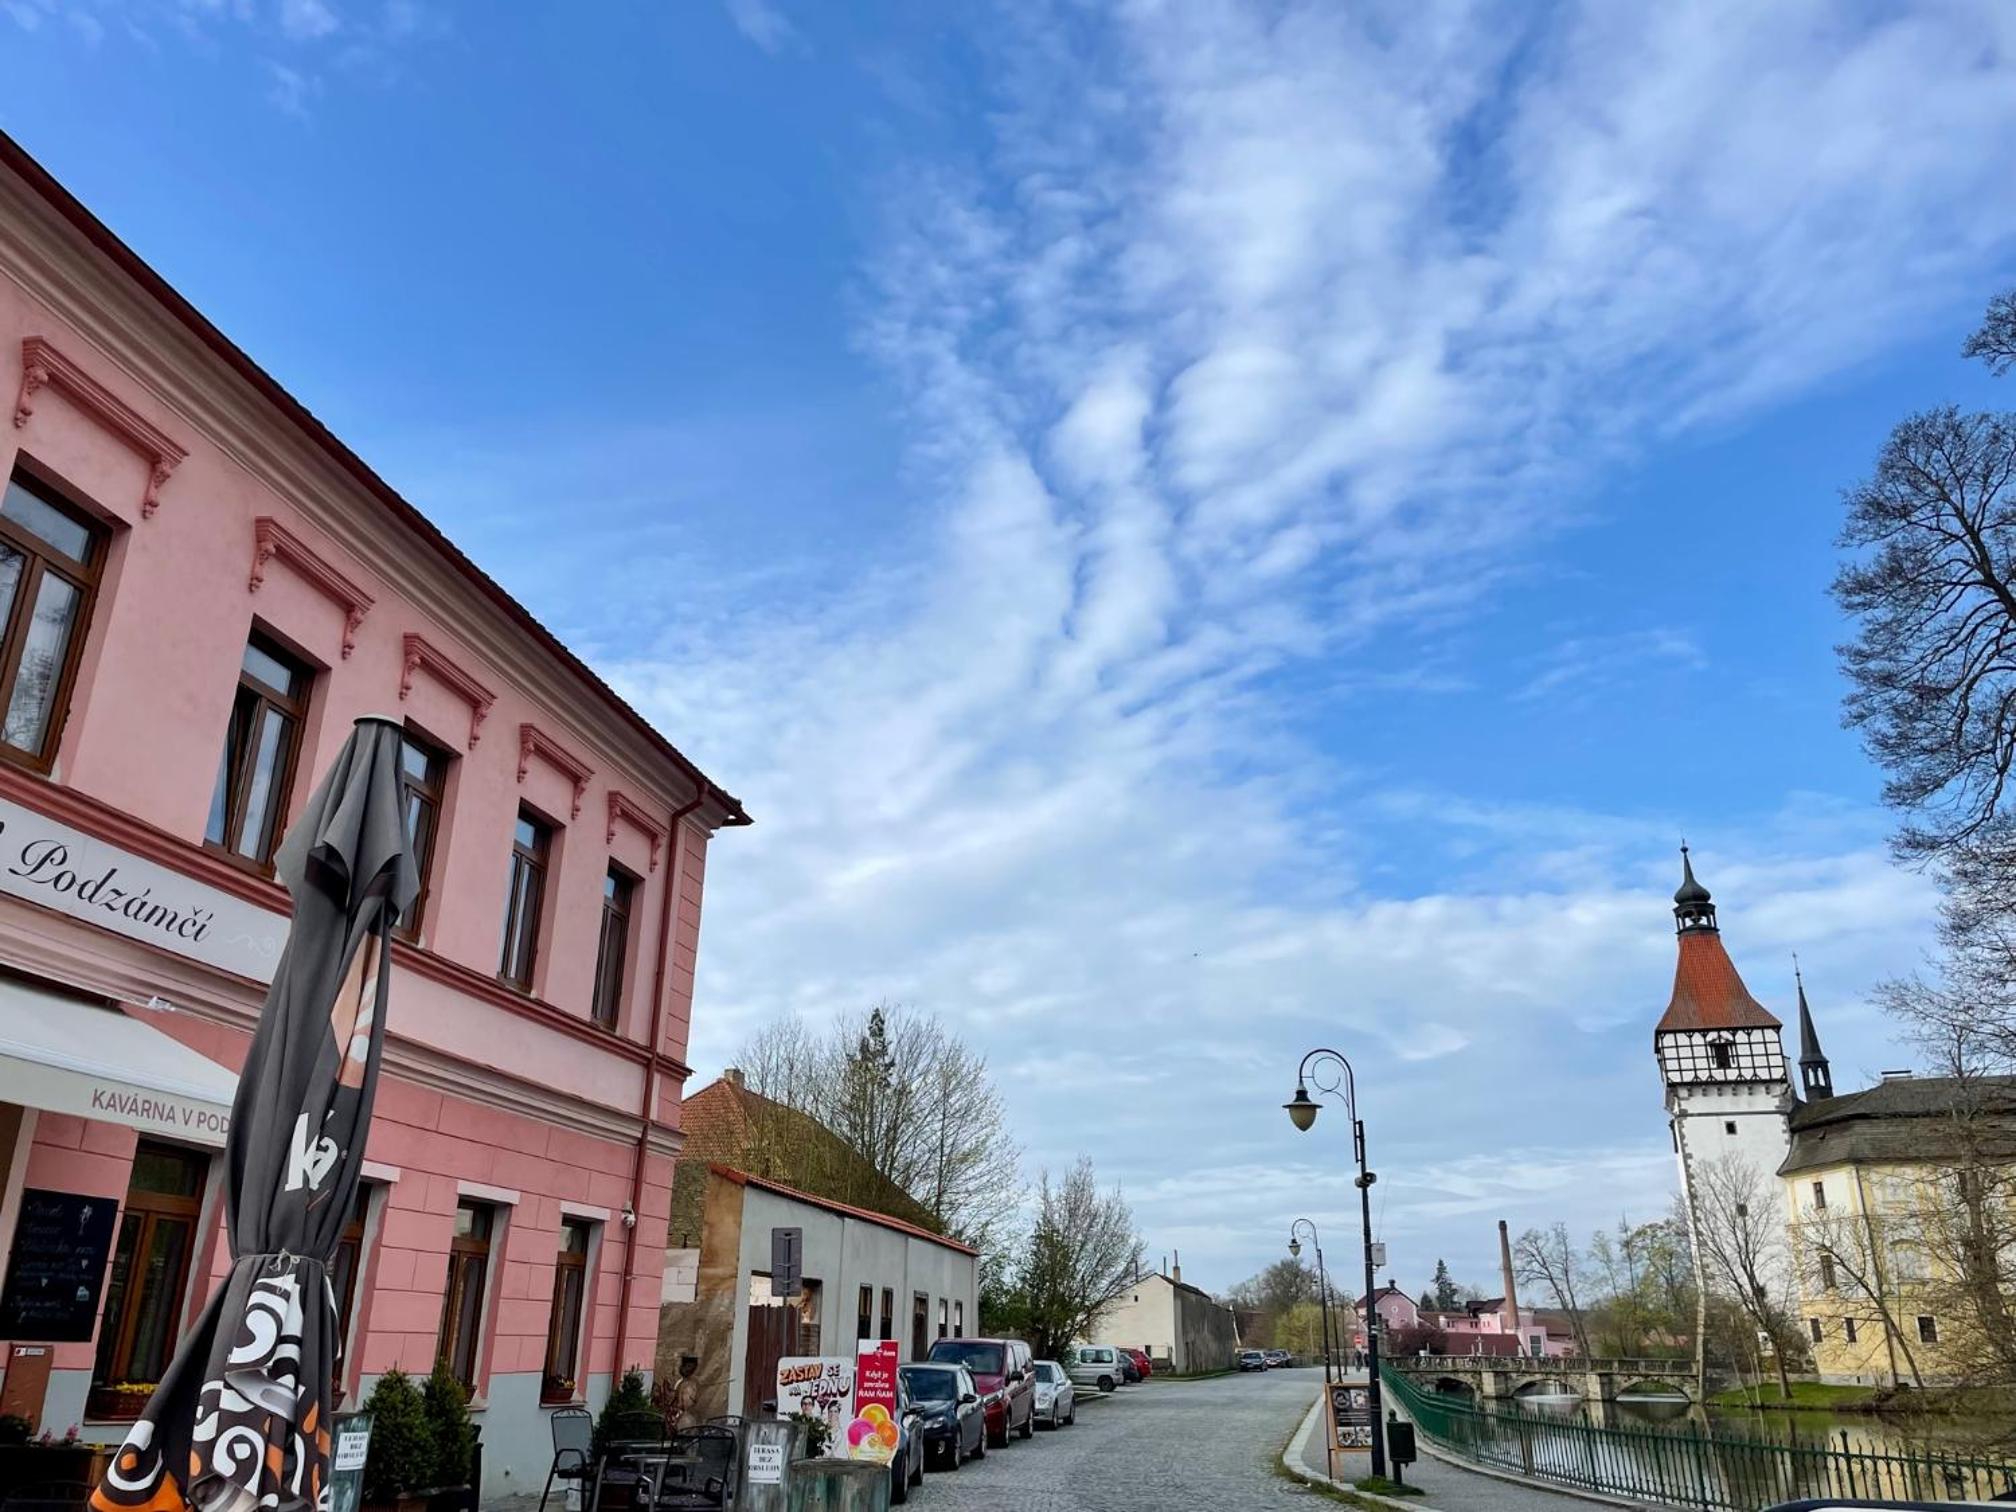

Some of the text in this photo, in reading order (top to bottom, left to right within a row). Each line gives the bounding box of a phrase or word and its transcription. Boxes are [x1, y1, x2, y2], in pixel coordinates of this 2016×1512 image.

[8, 839, 215, 942] Podzámčí
[91, 1087, 177, 1125] KAVÁRNA
[182, 1107, 194, 1127] V
[779, 1363, 841, 1386] ZASTAV SE
[803, 1376, 851, 1399] JEDNU
